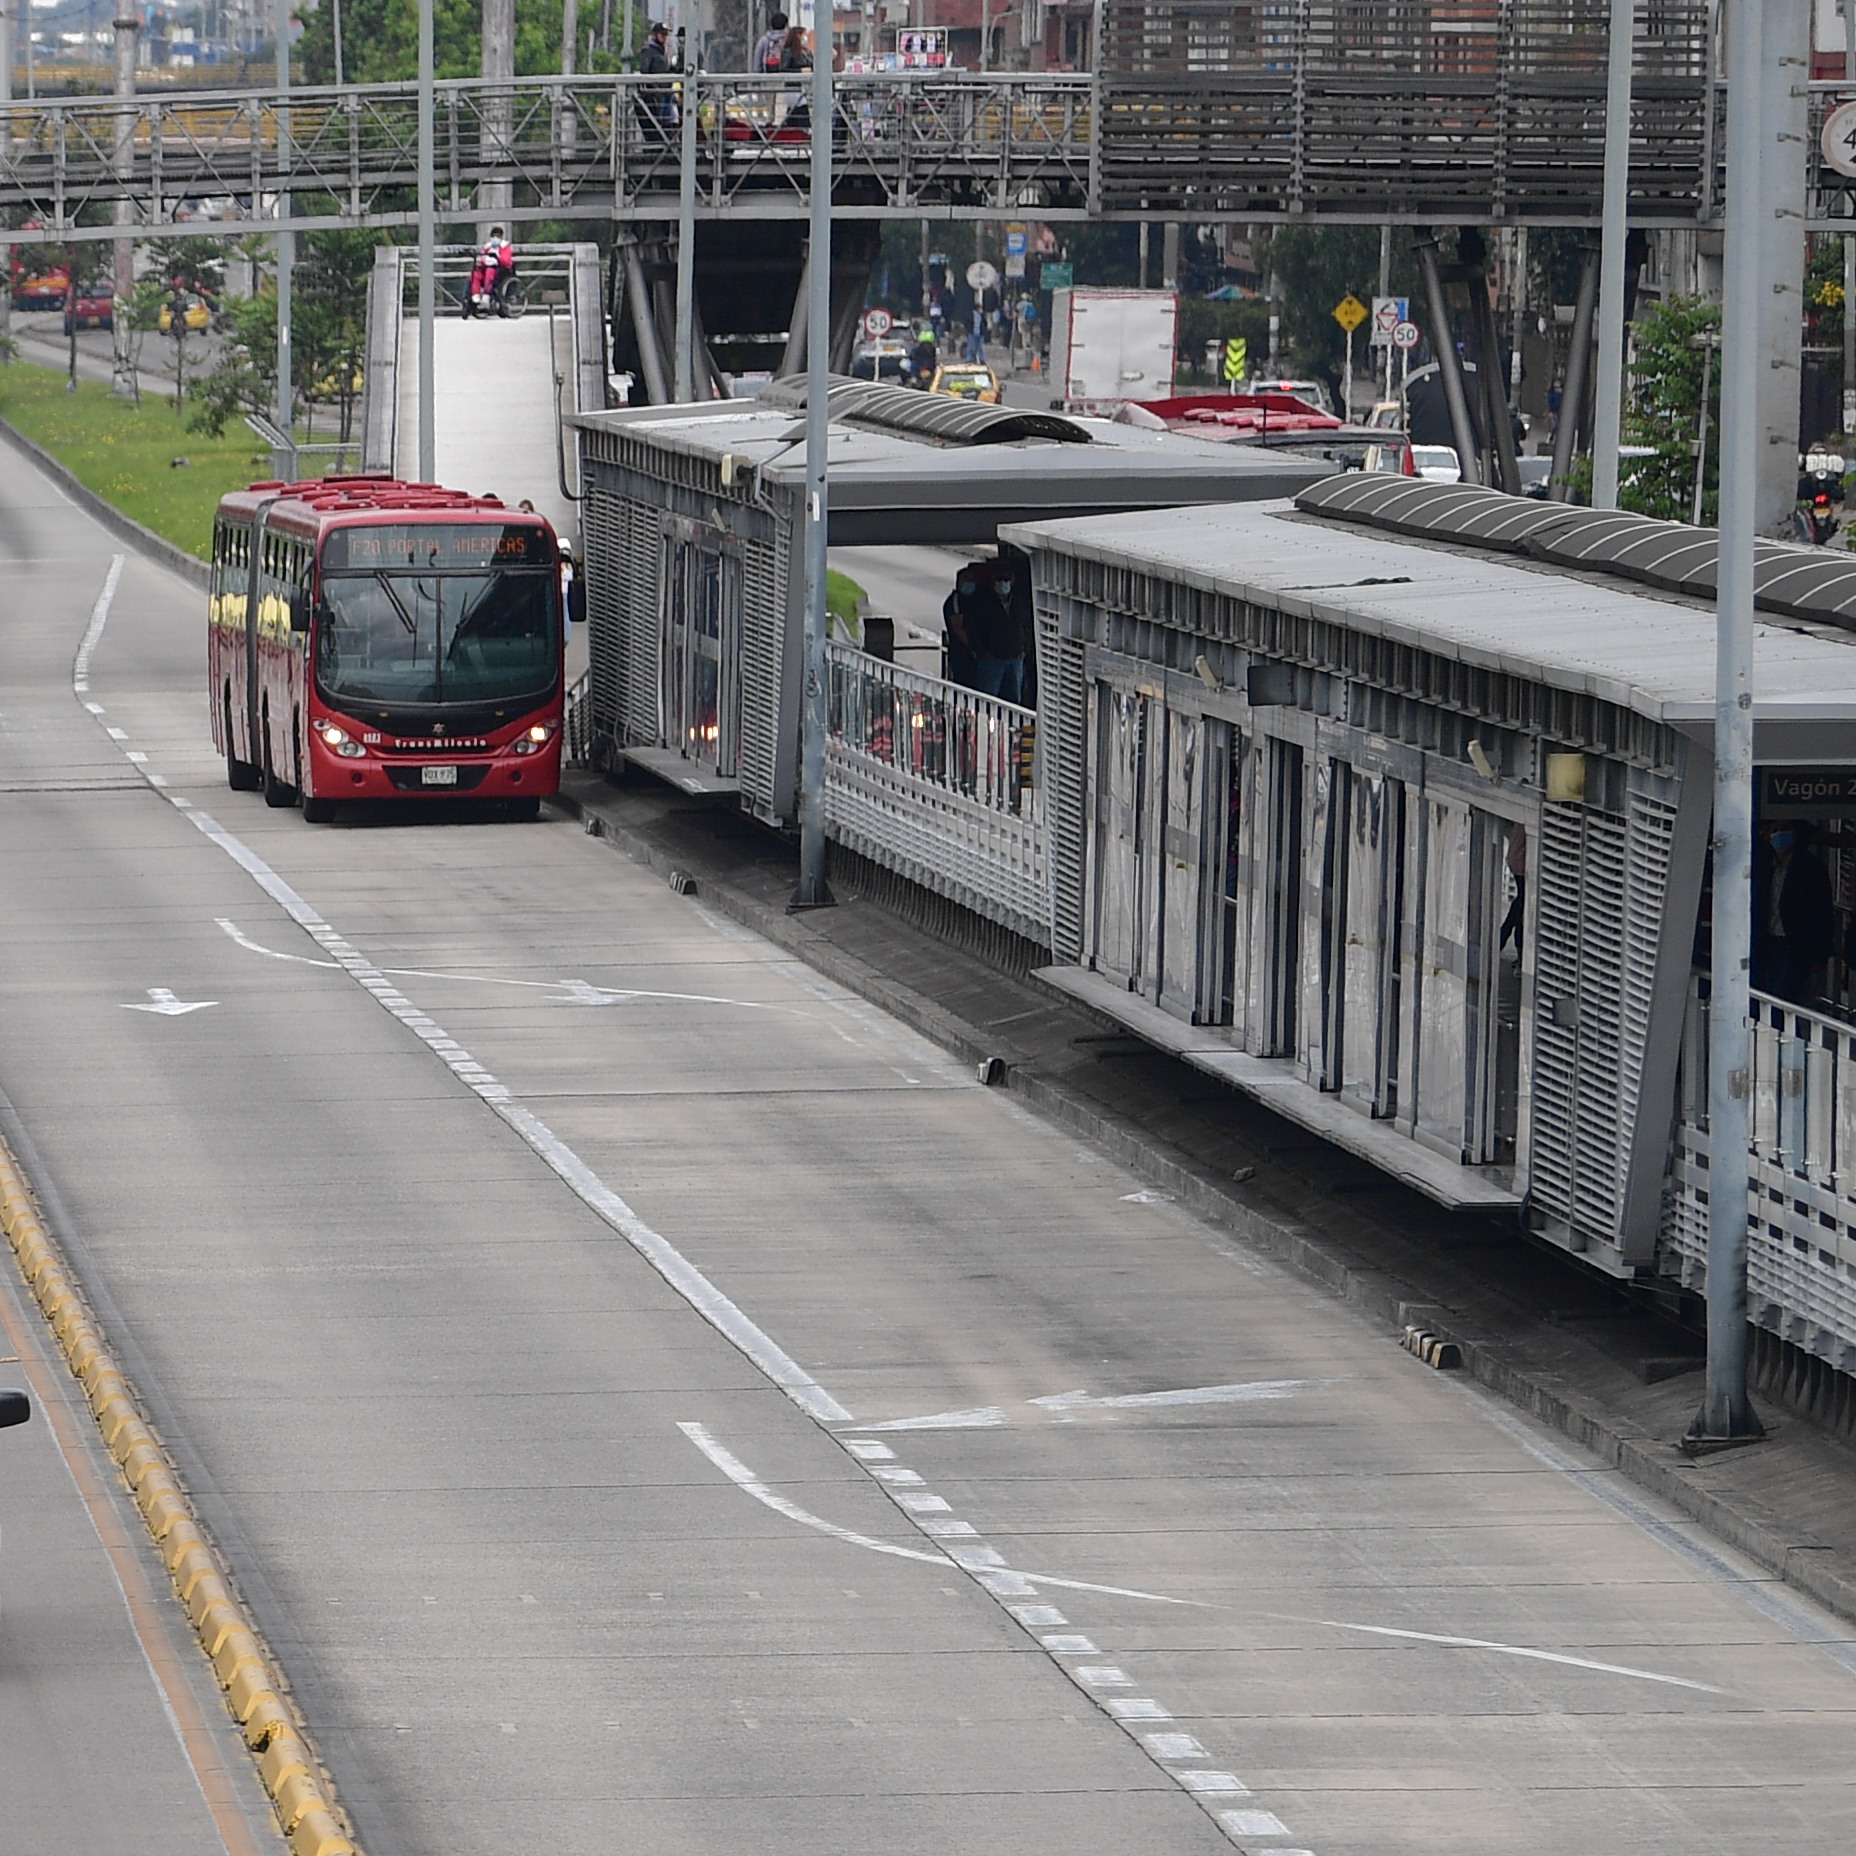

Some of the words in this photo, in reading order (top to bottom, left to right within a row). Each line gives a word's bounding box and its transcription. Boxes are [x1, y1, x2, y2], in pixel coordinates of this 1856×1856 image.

[869, 316, 888, 330] 50
[1396, 327, 1415, 342] 50
[352, 538, 381, 556] F20
[389, 538, 442, 556] PORTAL
[452, 536, 526, 555] AMERICAS
[1773, 778, 1841, 800] Vagón
